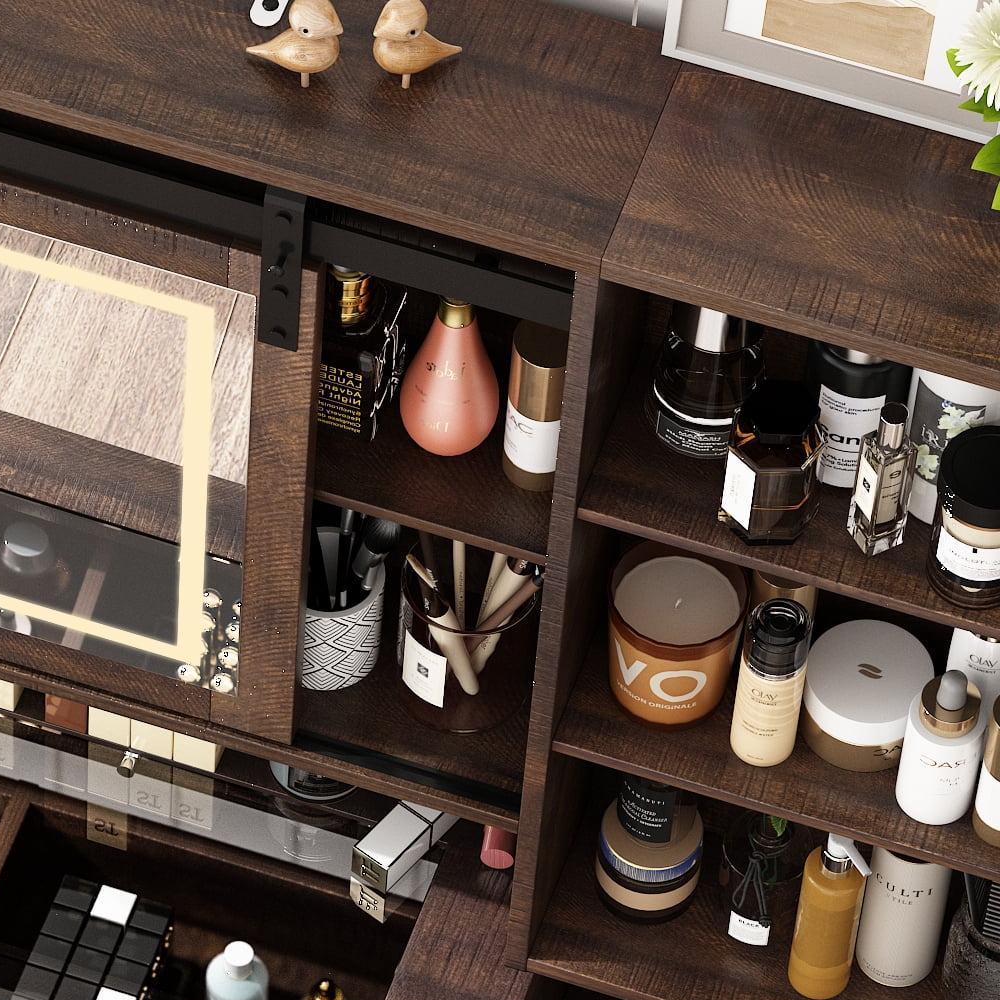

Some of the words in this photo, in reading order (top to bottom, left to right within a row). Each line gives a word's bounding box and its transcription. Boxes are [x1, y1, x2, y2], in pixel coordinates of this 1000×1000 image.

[614, 638, 707, 702] VO
[969, 654, 998, 669] OLAY
[751, 688, 779, 702] OLAY
[876, 872, 934, 898] CULTI
